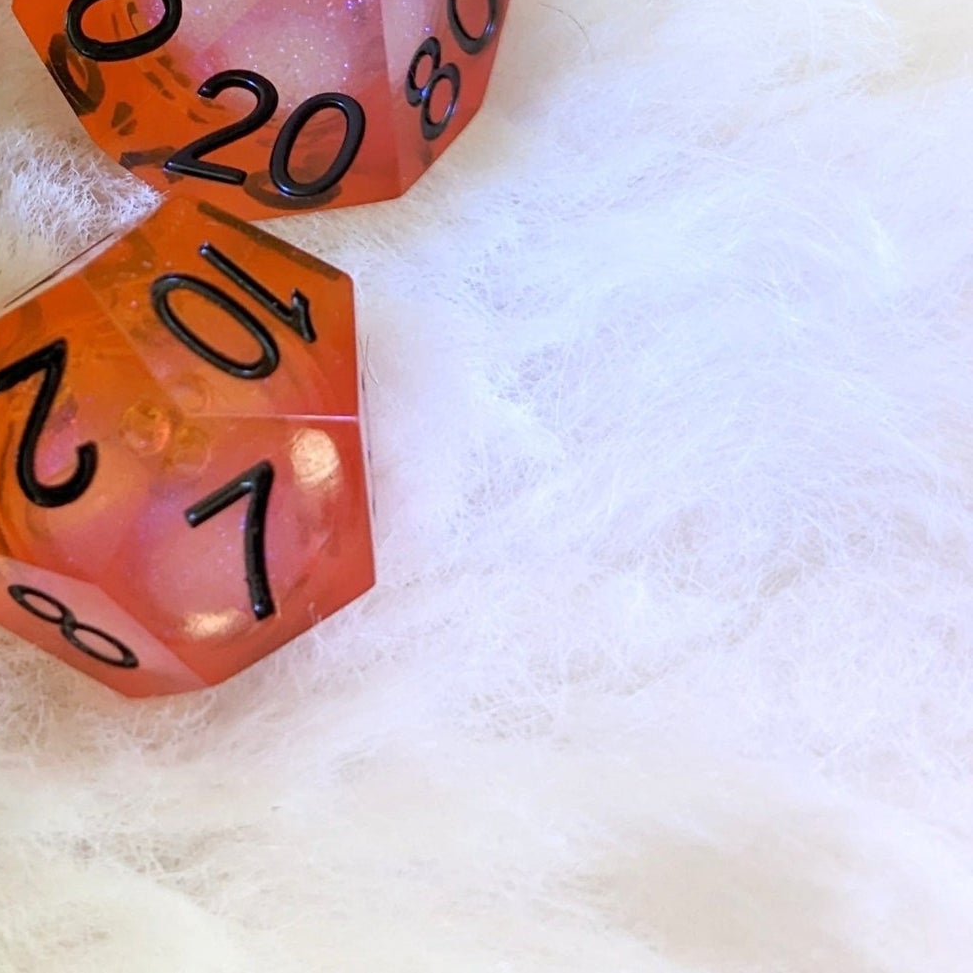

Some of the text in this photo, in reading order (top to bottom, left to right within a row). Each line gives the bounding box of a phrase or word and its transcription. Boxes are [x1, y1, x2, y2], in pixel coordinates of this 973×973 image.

[164, 69, 366, 197] 20
[150, 241, 316, 379] 10
[185, 460, 276, 621] 7
[8, 584, 139, 669] 8
